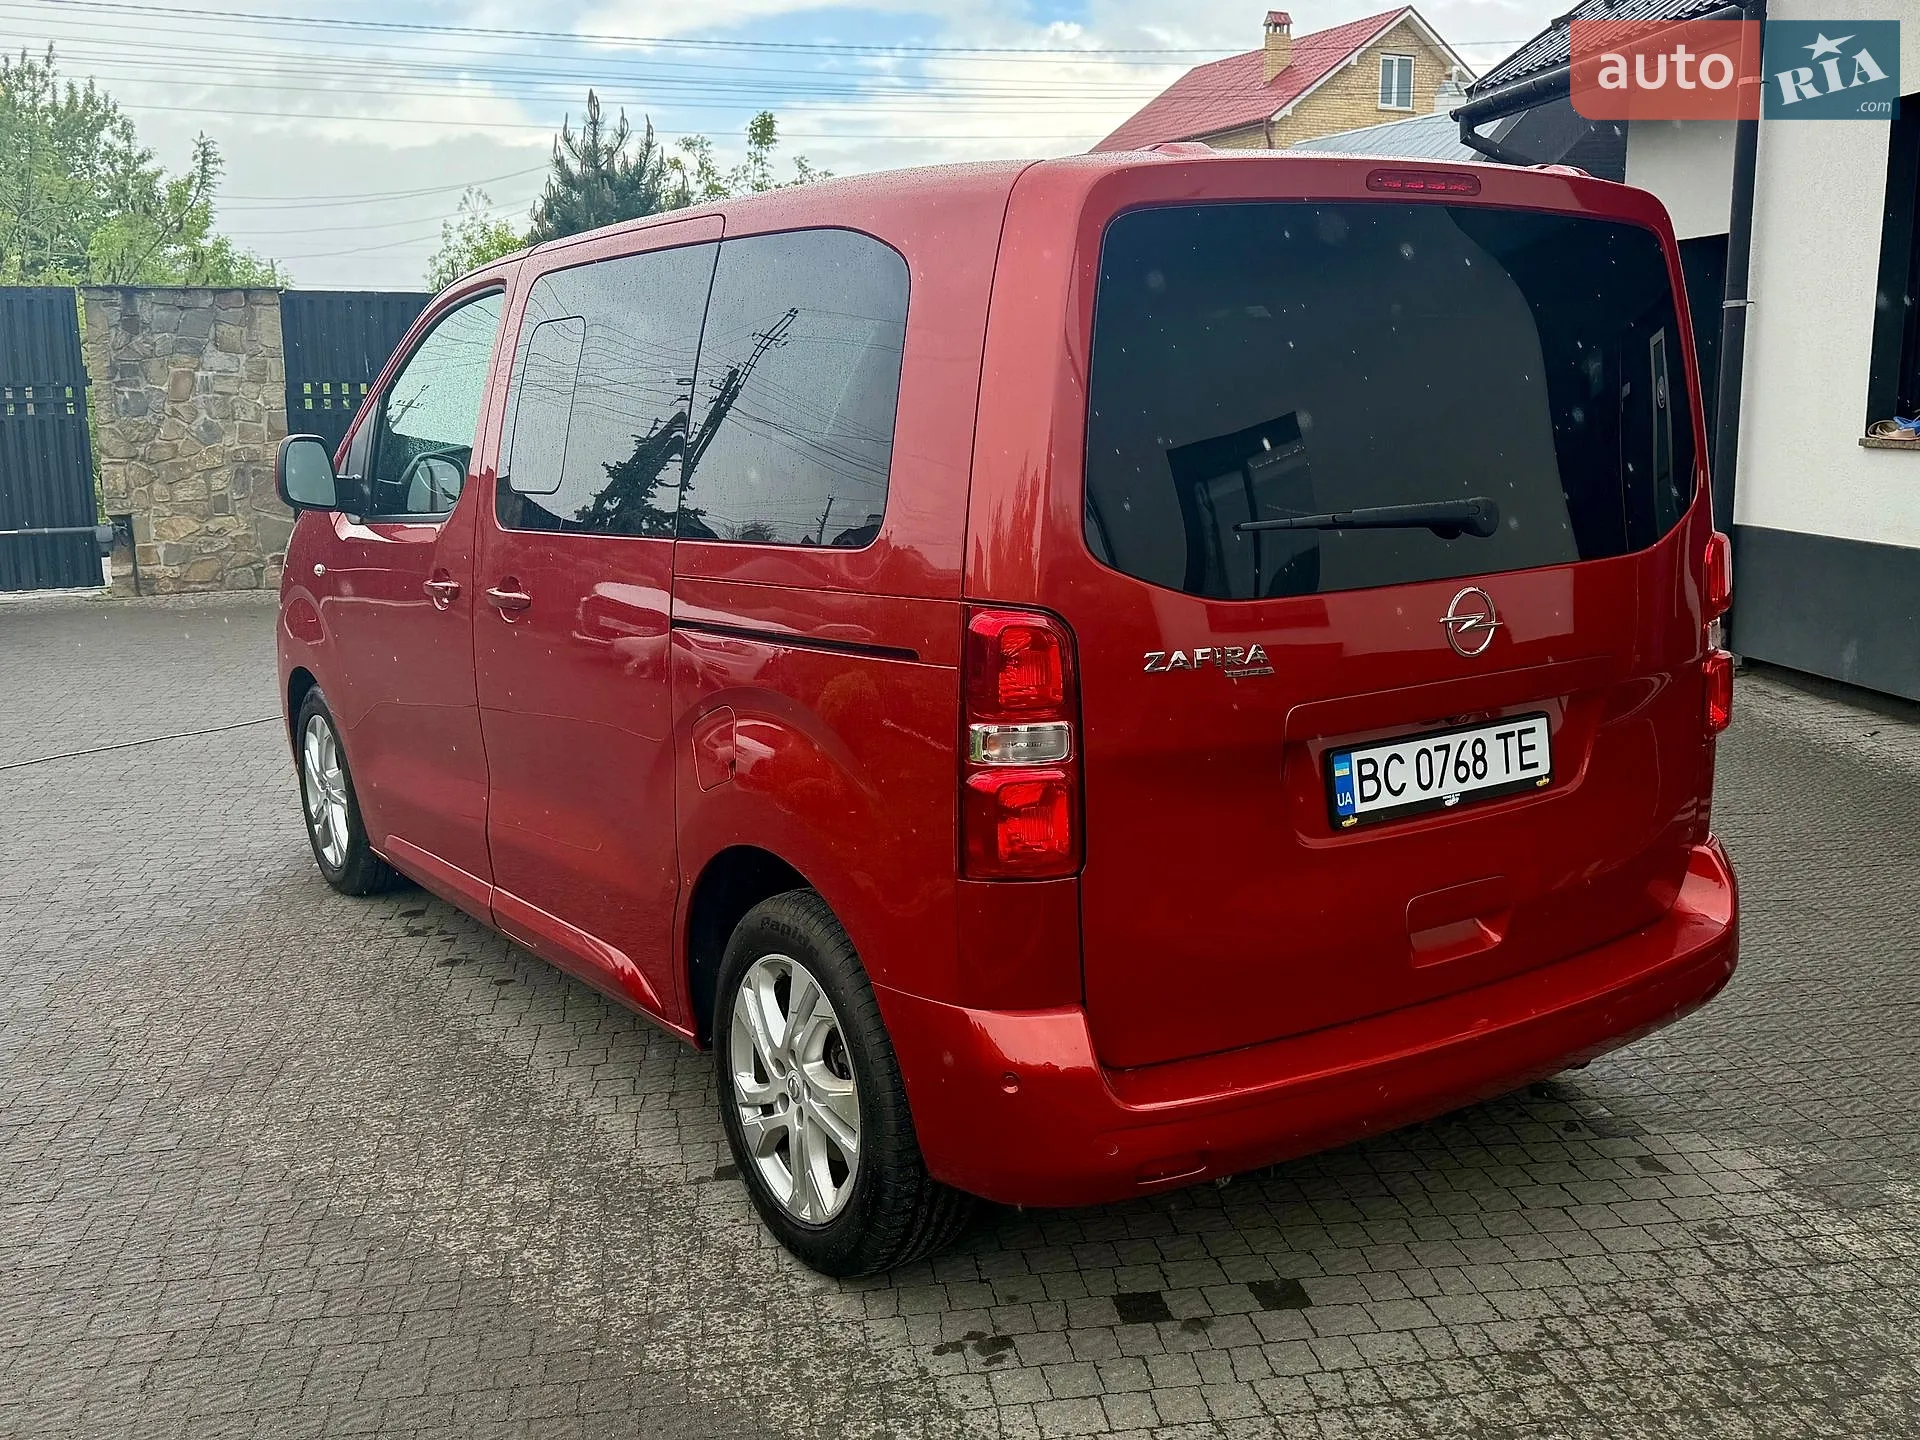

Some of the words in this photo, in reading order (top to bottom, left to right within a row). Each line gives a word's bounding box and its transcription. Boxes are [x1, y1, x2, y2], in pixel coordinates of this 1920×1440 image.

[1143, 644, 1270, 672] ZAFIRA
[1356, 752, 1407, 803] BC
[1415, 737, 1488, 791] 0768
[1496, 727, 1539, 775] TE
[1337, 791, 1353, 807] UA
